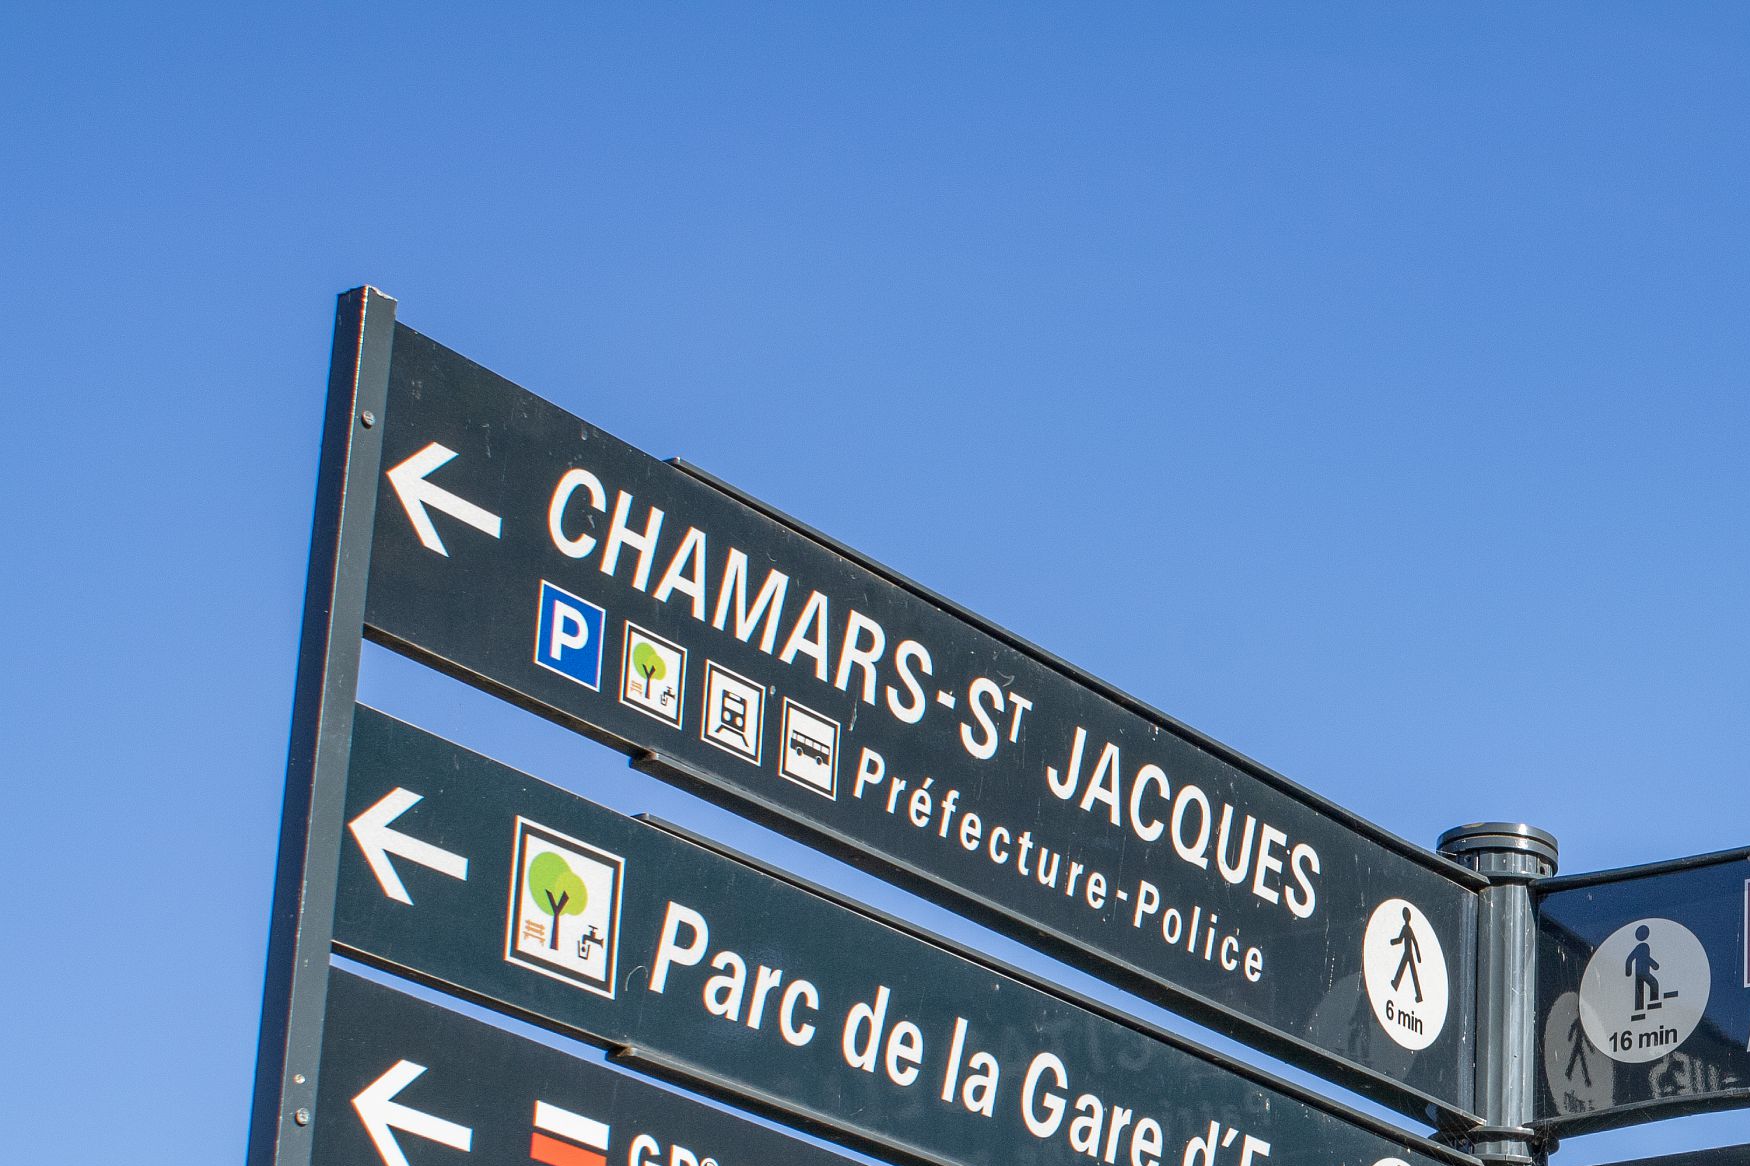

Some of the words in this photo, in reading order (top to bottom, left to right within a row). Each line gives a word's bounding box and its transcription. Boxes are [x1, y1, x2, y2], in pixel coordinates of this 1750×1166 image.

[853, 745, 1263, 982] Préfecture-Police
[1047, 727, 1321, 918] JACQUES
[650, 901, 818, 1046] Parc
[843, 986, 923, 1086] de
[942, 1017, 999, 1117] la
[1386, 1000, 1395, 1021] 6
[1398, 1009, 1423, 1035] min
[1608, 1031, 1633, 1052] 16
[1638, 1025, 1678, 1048] min
